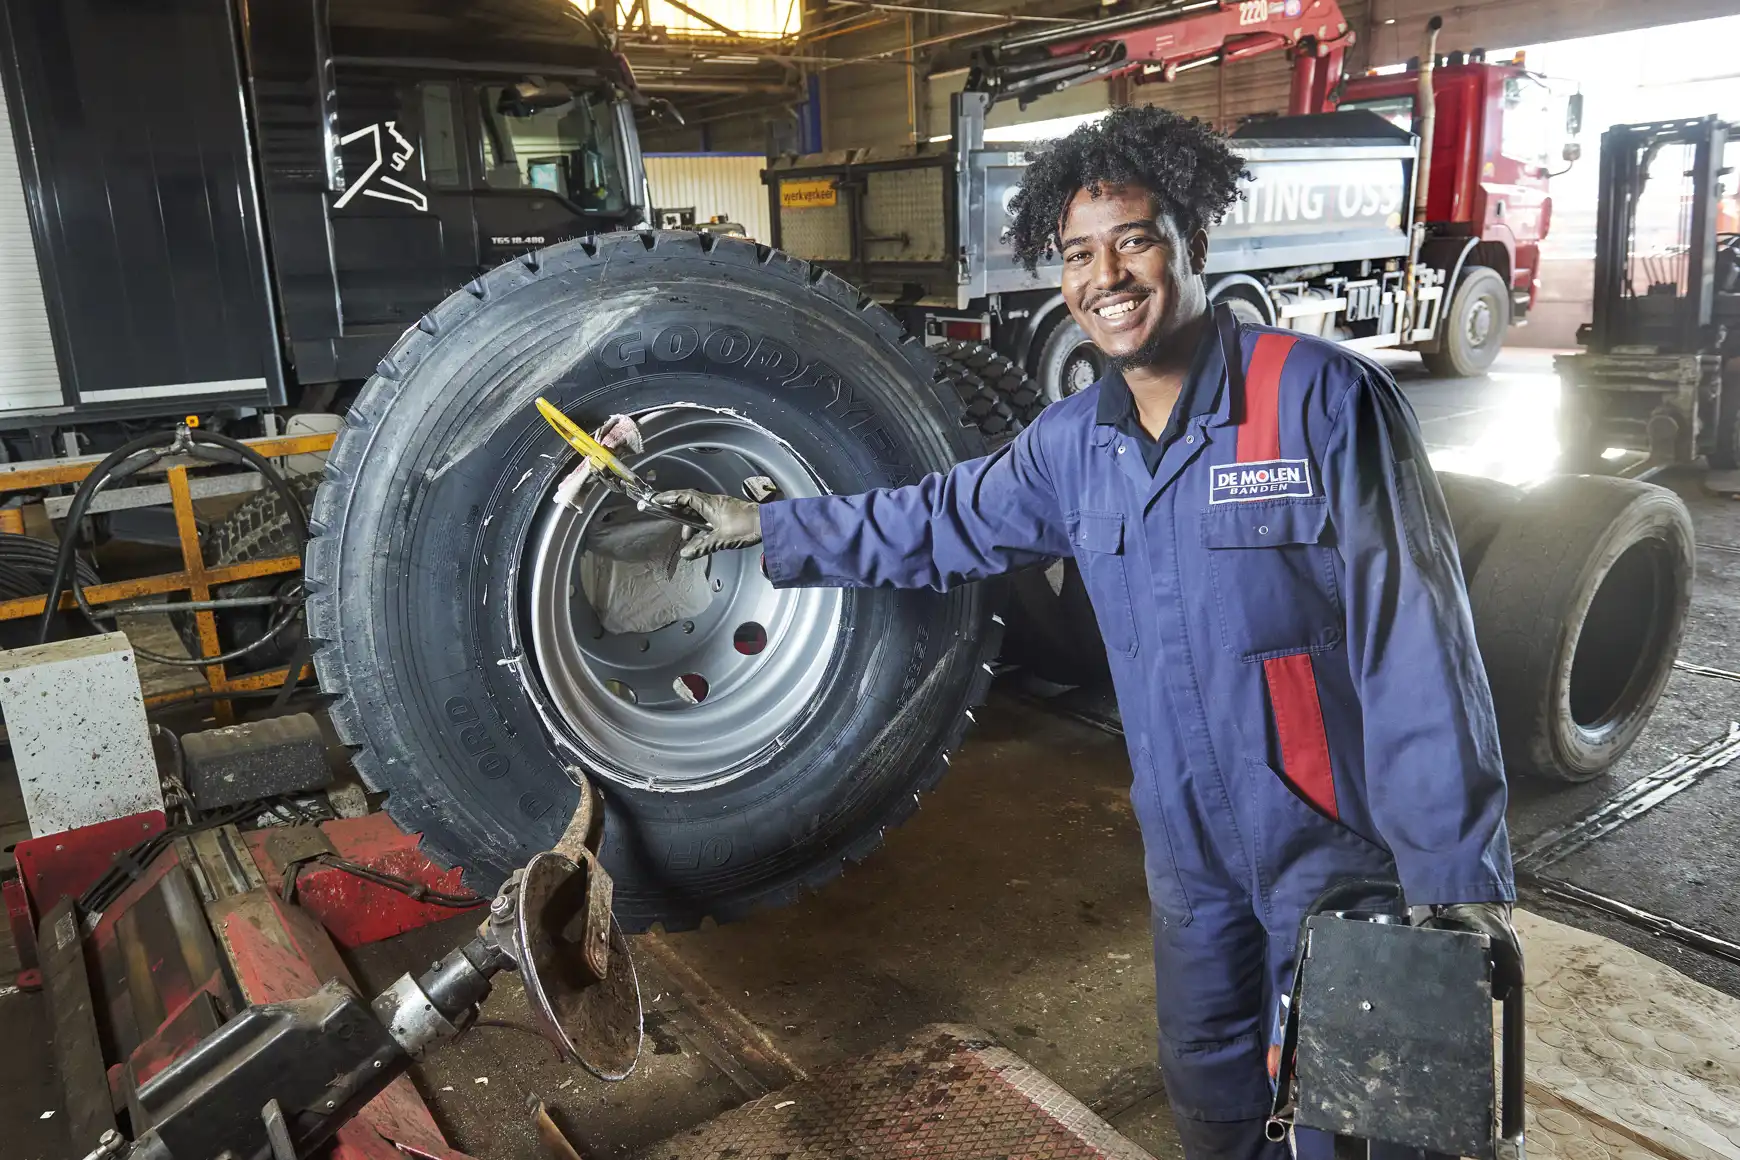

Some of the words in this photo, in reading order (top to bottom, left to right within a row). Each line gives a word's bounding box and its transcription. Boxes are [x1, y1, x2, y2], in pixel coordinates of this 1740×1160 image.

[1240, 0, 1268, 26] 2220
[1210, 178, 1324, 226] ATING
[1338, 182, 1398, 218] OSS
[1218, 472, 1238, 487] DE
[1240, 467, 1301, 486] MOLEN
[1229, 483, 1288, 494] BANDEN
